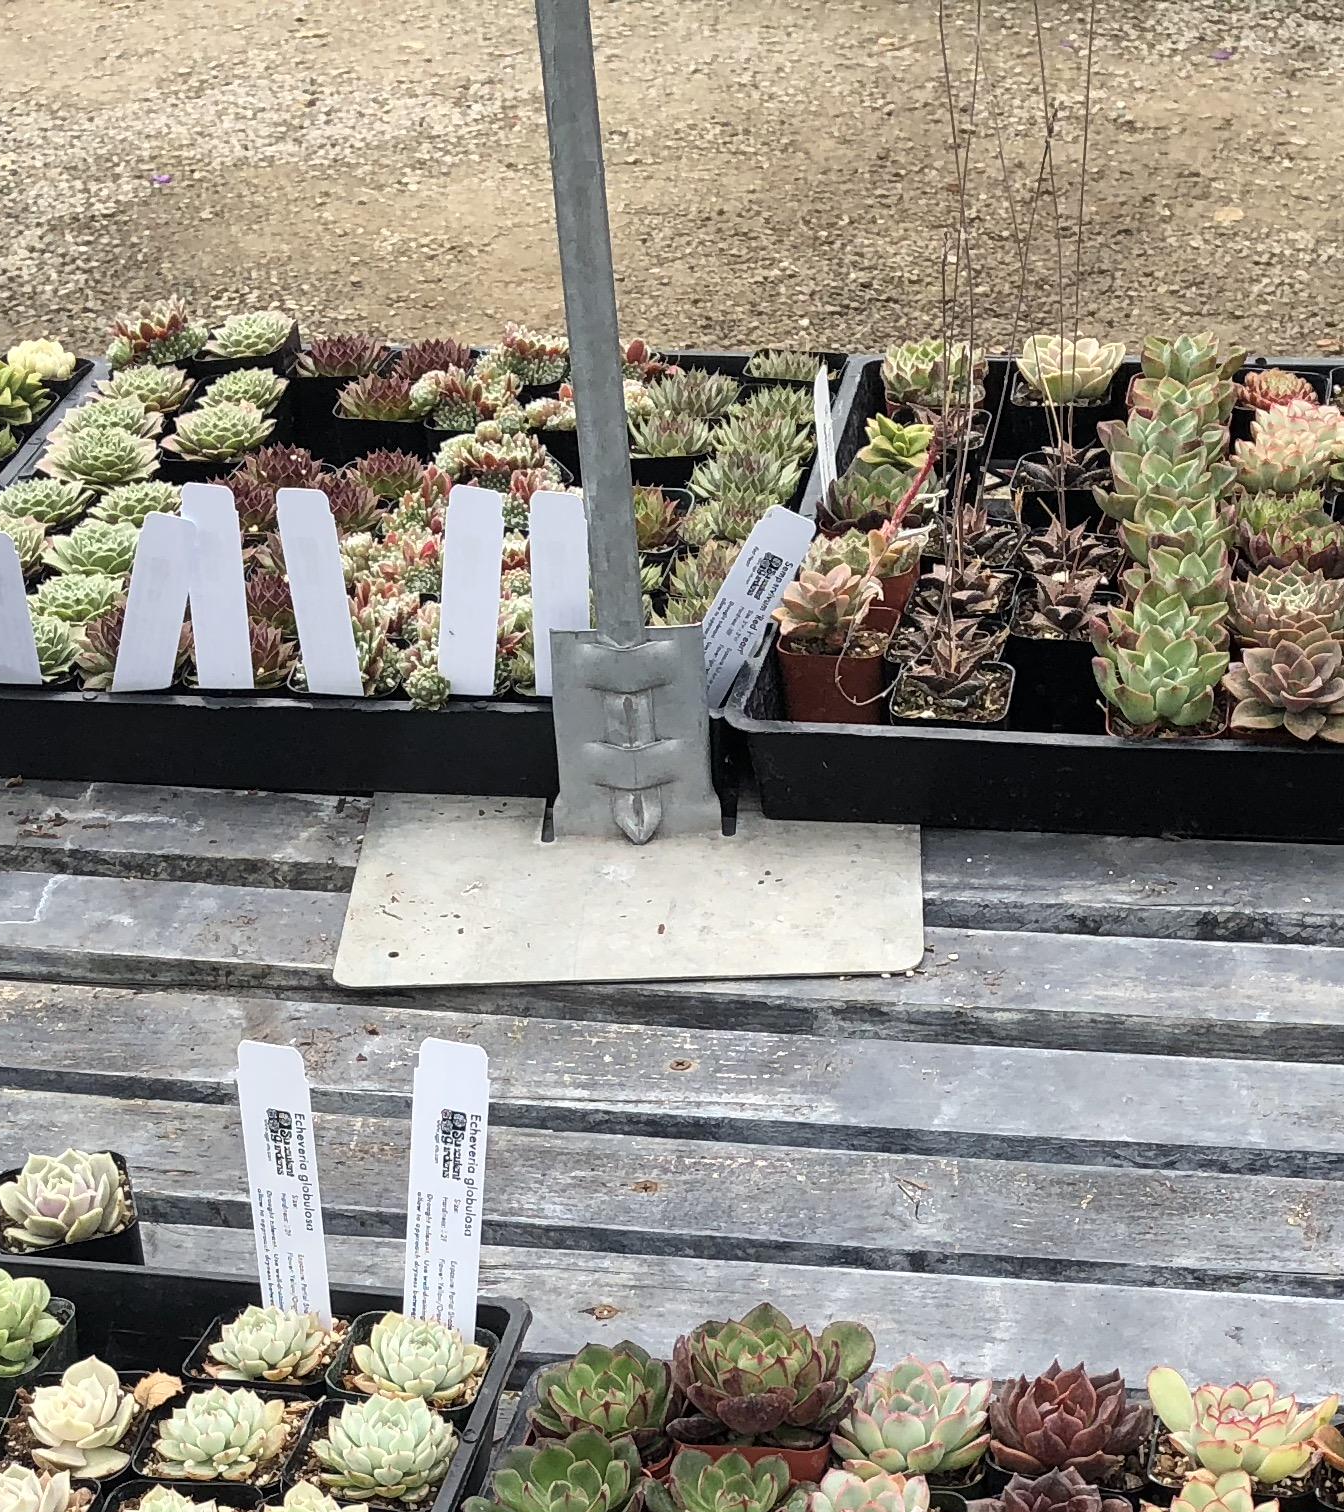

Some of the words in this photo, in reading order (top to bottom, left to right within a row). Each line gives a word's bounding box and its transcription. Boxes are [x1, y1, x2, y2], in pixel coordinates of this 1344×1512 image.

[294, 1113, 310, 1171] Echeveria
[467, 1113, 482, 1174] Echeveria
[297, 1174, 316, 1232] globulosa
[463, 1177, 479, 1237] globulosa
